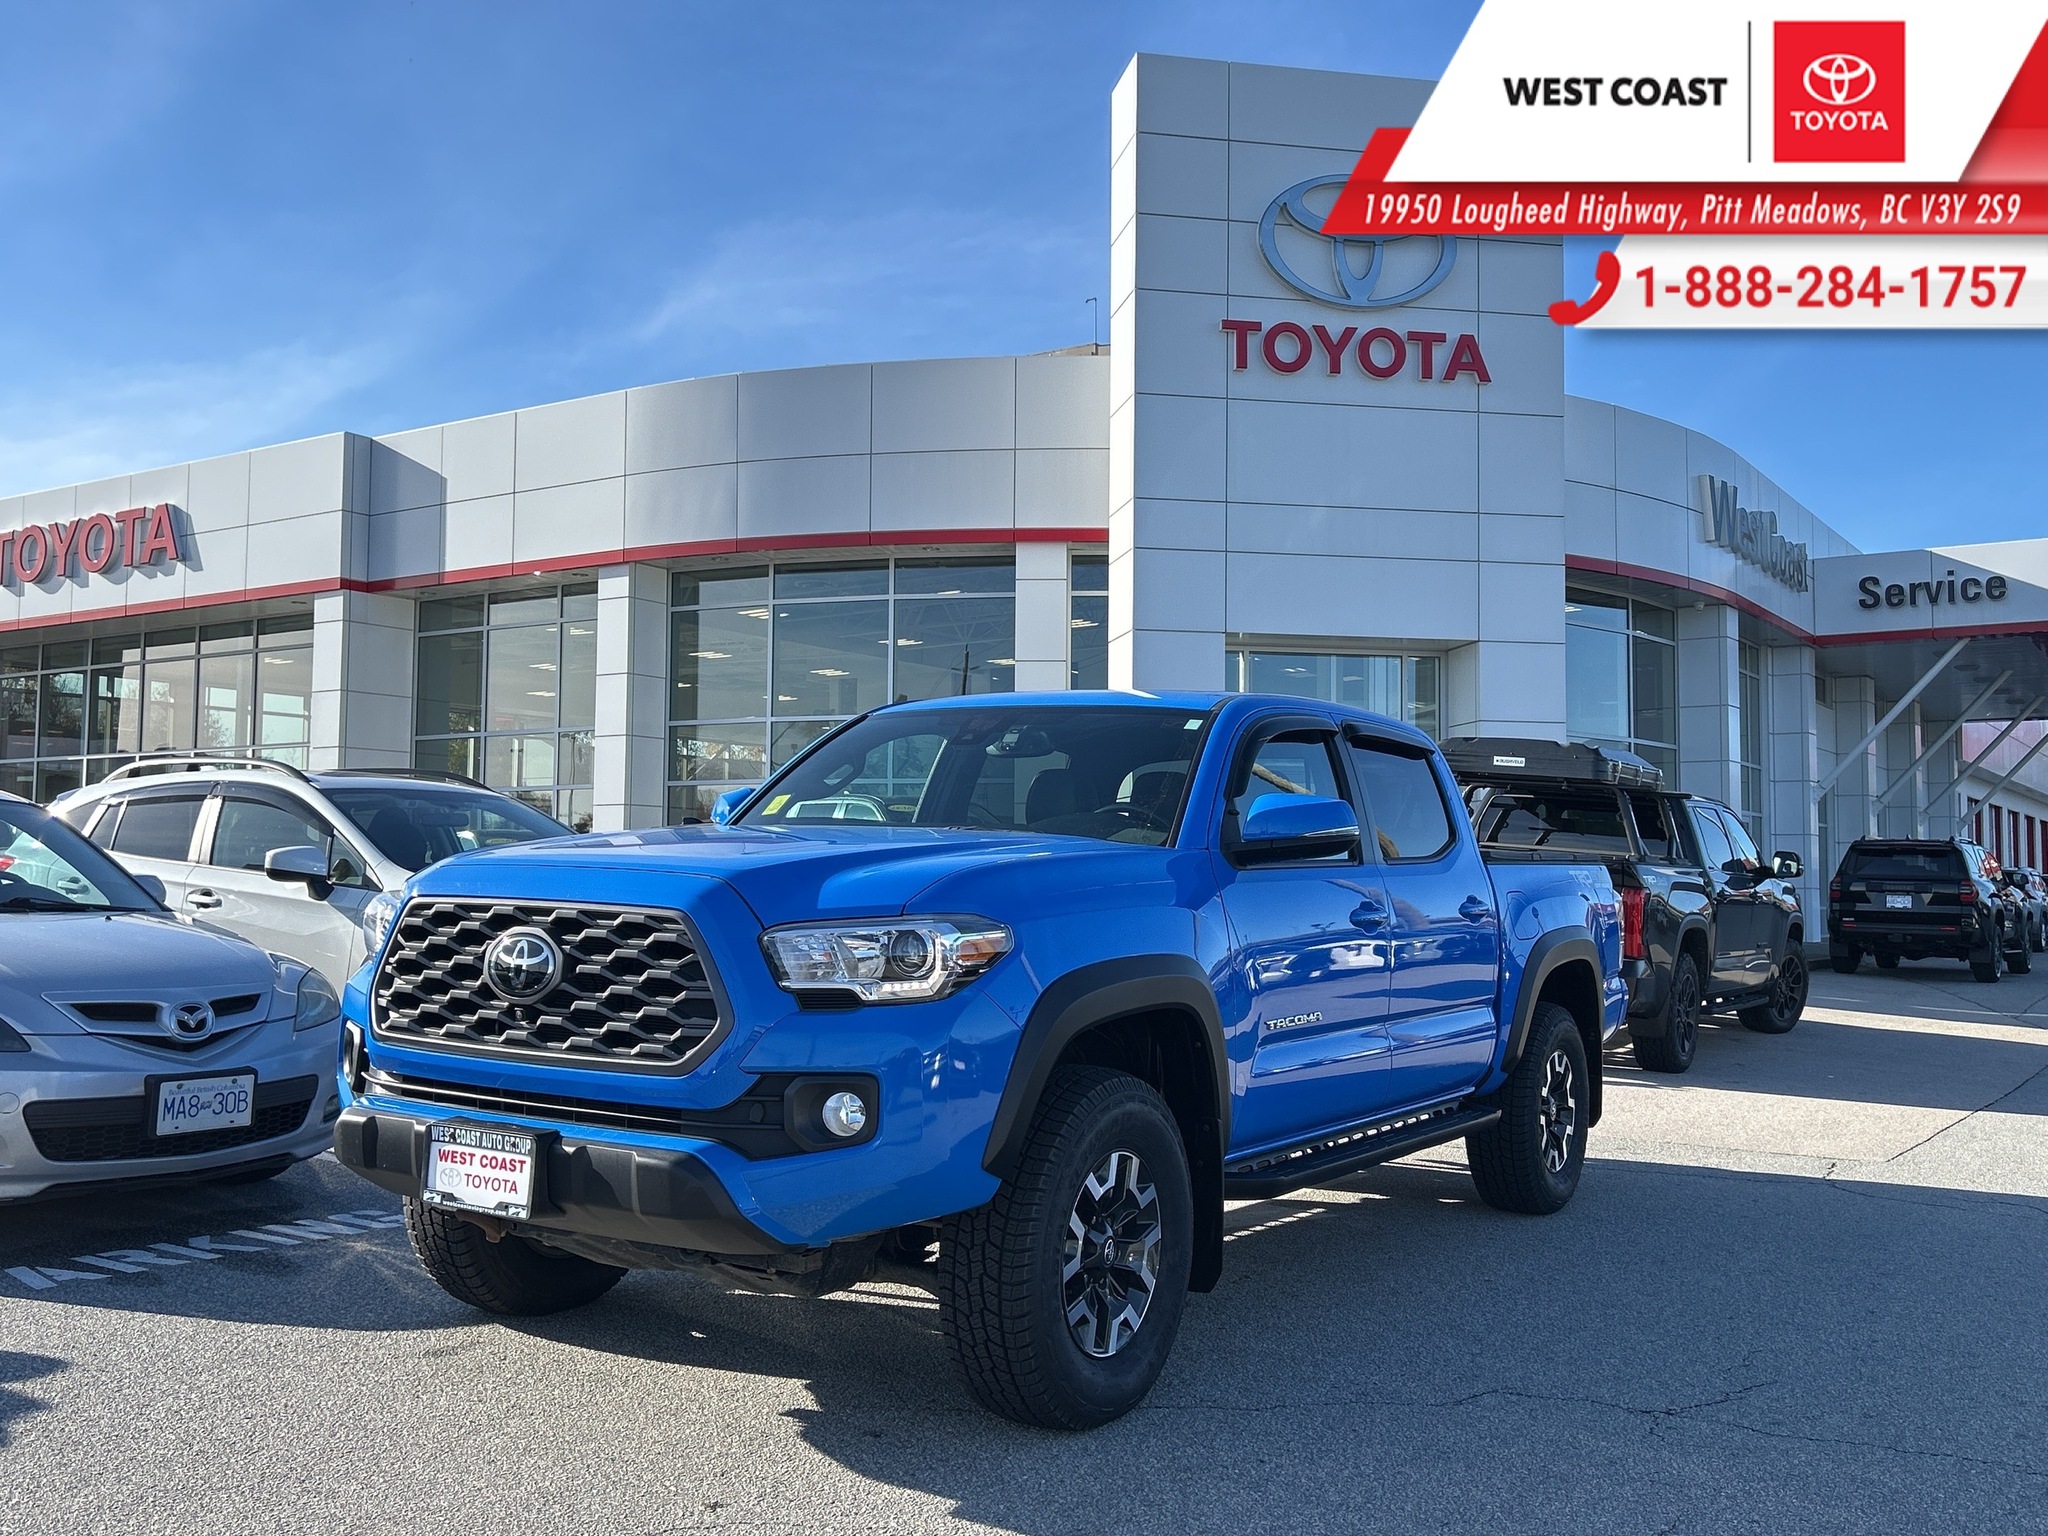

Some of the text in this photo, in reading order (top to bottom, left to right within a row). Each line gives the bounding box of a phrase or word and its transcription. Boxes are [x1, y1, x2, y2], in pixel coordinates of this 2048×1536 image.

[1219, 318, 1492, 385] TOYOTA
[1858, 569, 2008, 609] Service
[1265, 1011, 1323, 1030] TACOMA
[455, 1129, 481, 1147] COAST
[482, 1133, 502, 1151] AUTO
[438, 1149, 526, 1174] WEST COAST
[464, 1173, 518, 1195] TOYOTA
